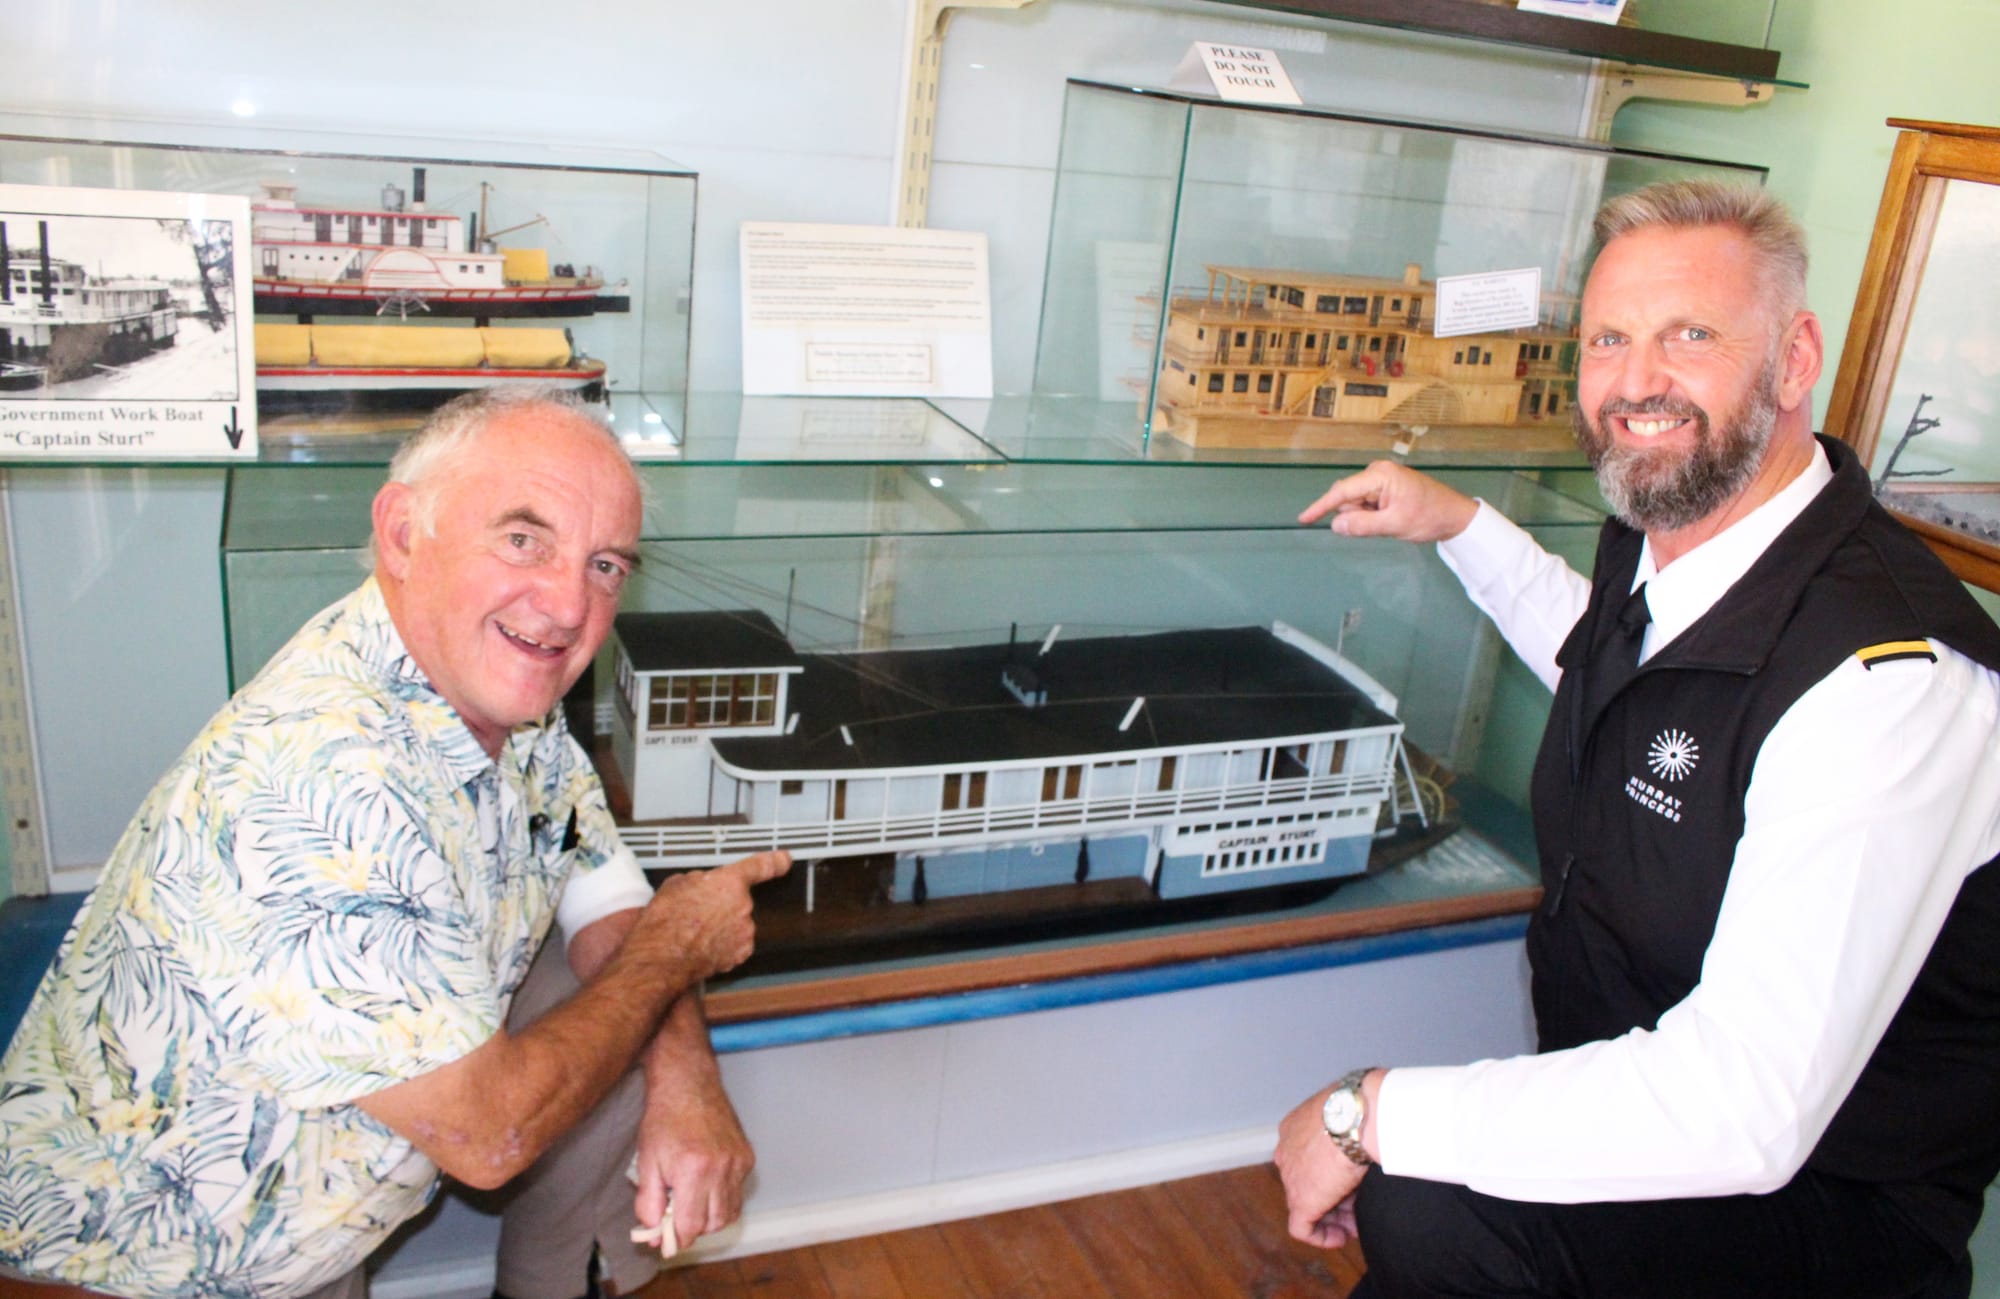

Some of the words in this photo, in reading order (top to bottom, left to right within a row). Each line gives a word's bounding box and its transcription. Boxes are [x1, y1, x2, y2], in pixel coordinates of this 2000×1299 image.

[1211, 47, 1264, 61] PLEASE
[1214, 60, 1236, 71] DO
[1241, 63, 1270, 75] NOT
[1225, 75, 1276, 88] TOUCH
[110, 407, 159, 422] Work
[165, 407, 204, 422] Boat
[3, 431, 92, 450] “Captain
[97, 431, 155, 446] Sturt”
[1629, 775, 1683, 811] MURRAY
[1624, 781, 1681, 823] PRINCESS
[1218, 835, 1269, 849] CAPTAIN
[1279, 829, 1317, 841] STURT
